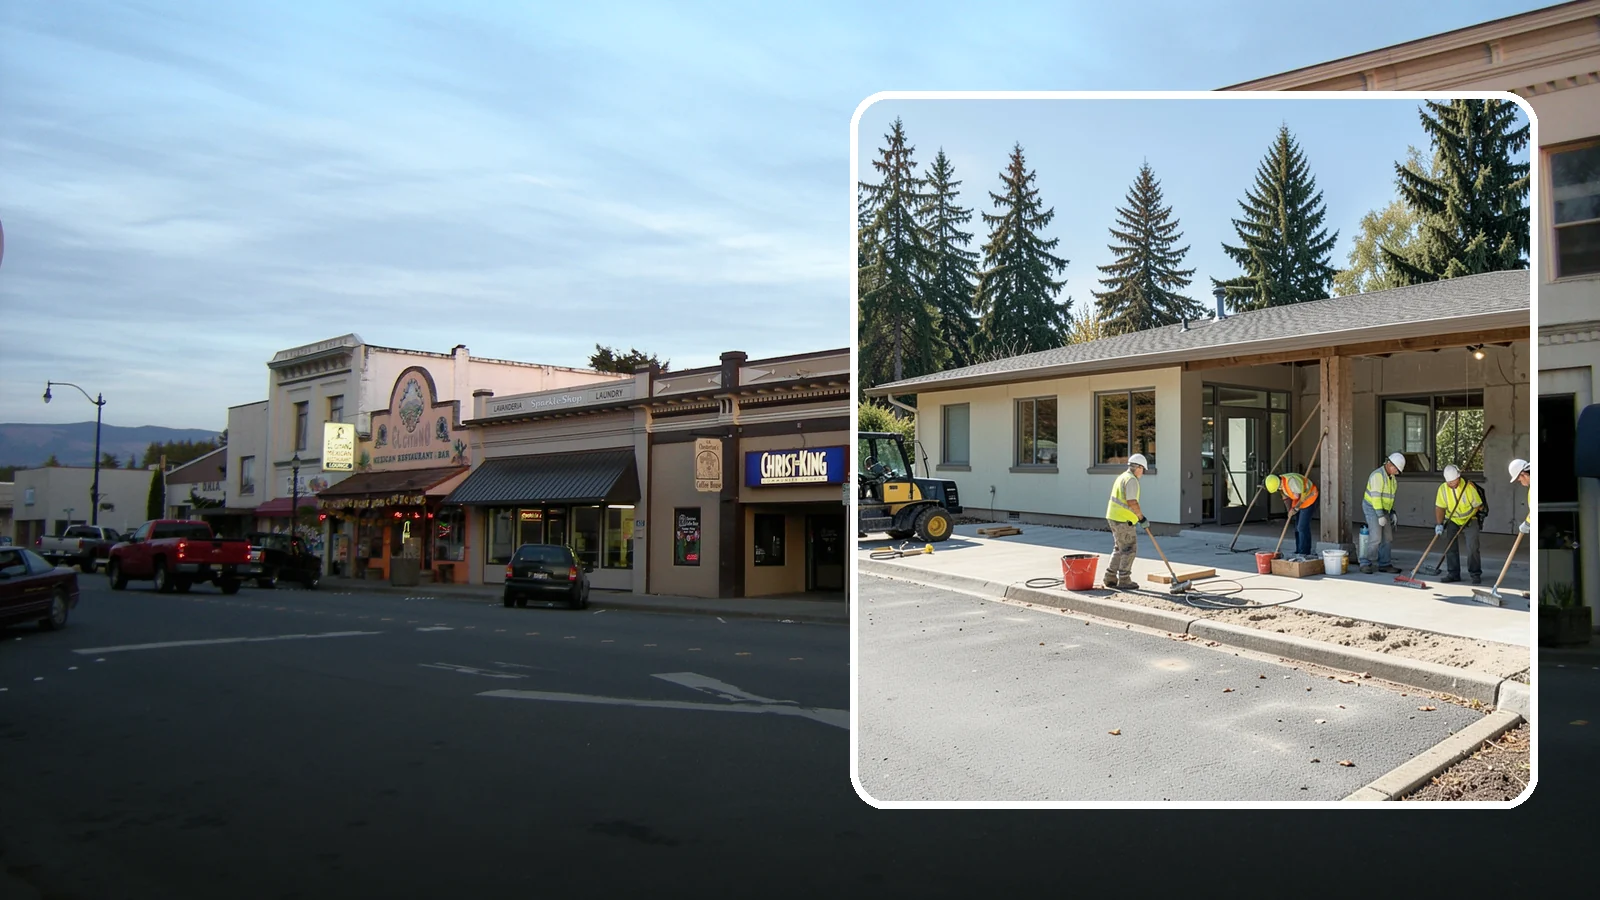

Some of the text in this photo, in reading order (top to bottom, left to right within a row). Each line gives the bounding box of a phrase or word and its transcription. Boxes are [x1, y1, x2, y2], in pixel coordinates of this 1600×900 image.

[530, 394, 583, 409] Sparkle Shop
[595, 389, 624, 400] LAUNDRY
[493, 402, 522, 413] LAVANDERIA
[391, 425, 402, 450] EL
[373, 455, 396, 464] MEXICAN
[397, 451, 434, 462] RESTAURANT
[437, 450, 450, 459] BAR
[761, 450, 828, 478] CHRIST KING
[696, 480, 722, 489] Coffee House
